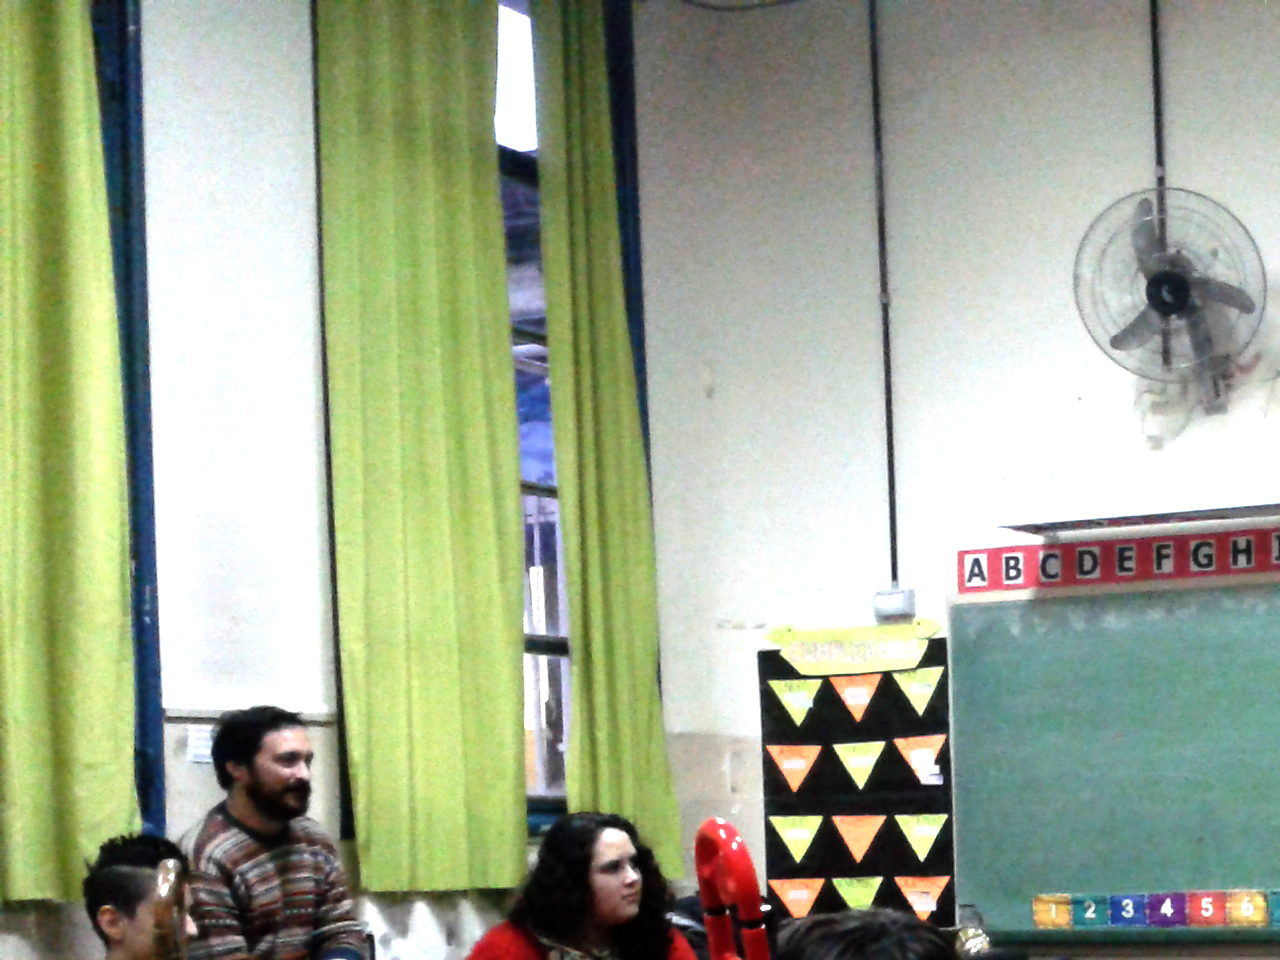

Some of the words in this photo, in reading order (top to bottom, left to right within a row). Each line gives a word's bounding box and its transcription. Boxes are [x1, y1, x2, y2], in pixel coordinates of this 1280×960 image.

[967, 558, 986, 583] A
[1004, 556, 1022, 581] B
[1040, 554, 1059, 579] C
[1078, 550, 1098, 575] D
[1118, 547, 1135, 572] E
[1155, 544, 1172, 570] F
[1192, 542, 1214, 569] G
[1231, 537, 1253, 566] H
[1050, 903, 1056, 919] 1
[1084, 900, 1096, 919] 2
[1121, 900, 1135, 918] 3
[1160, 898, 1174, 917] 4
[1201, 898, 1214, 917] 5
[1241, 897, 1254, 917] 6
